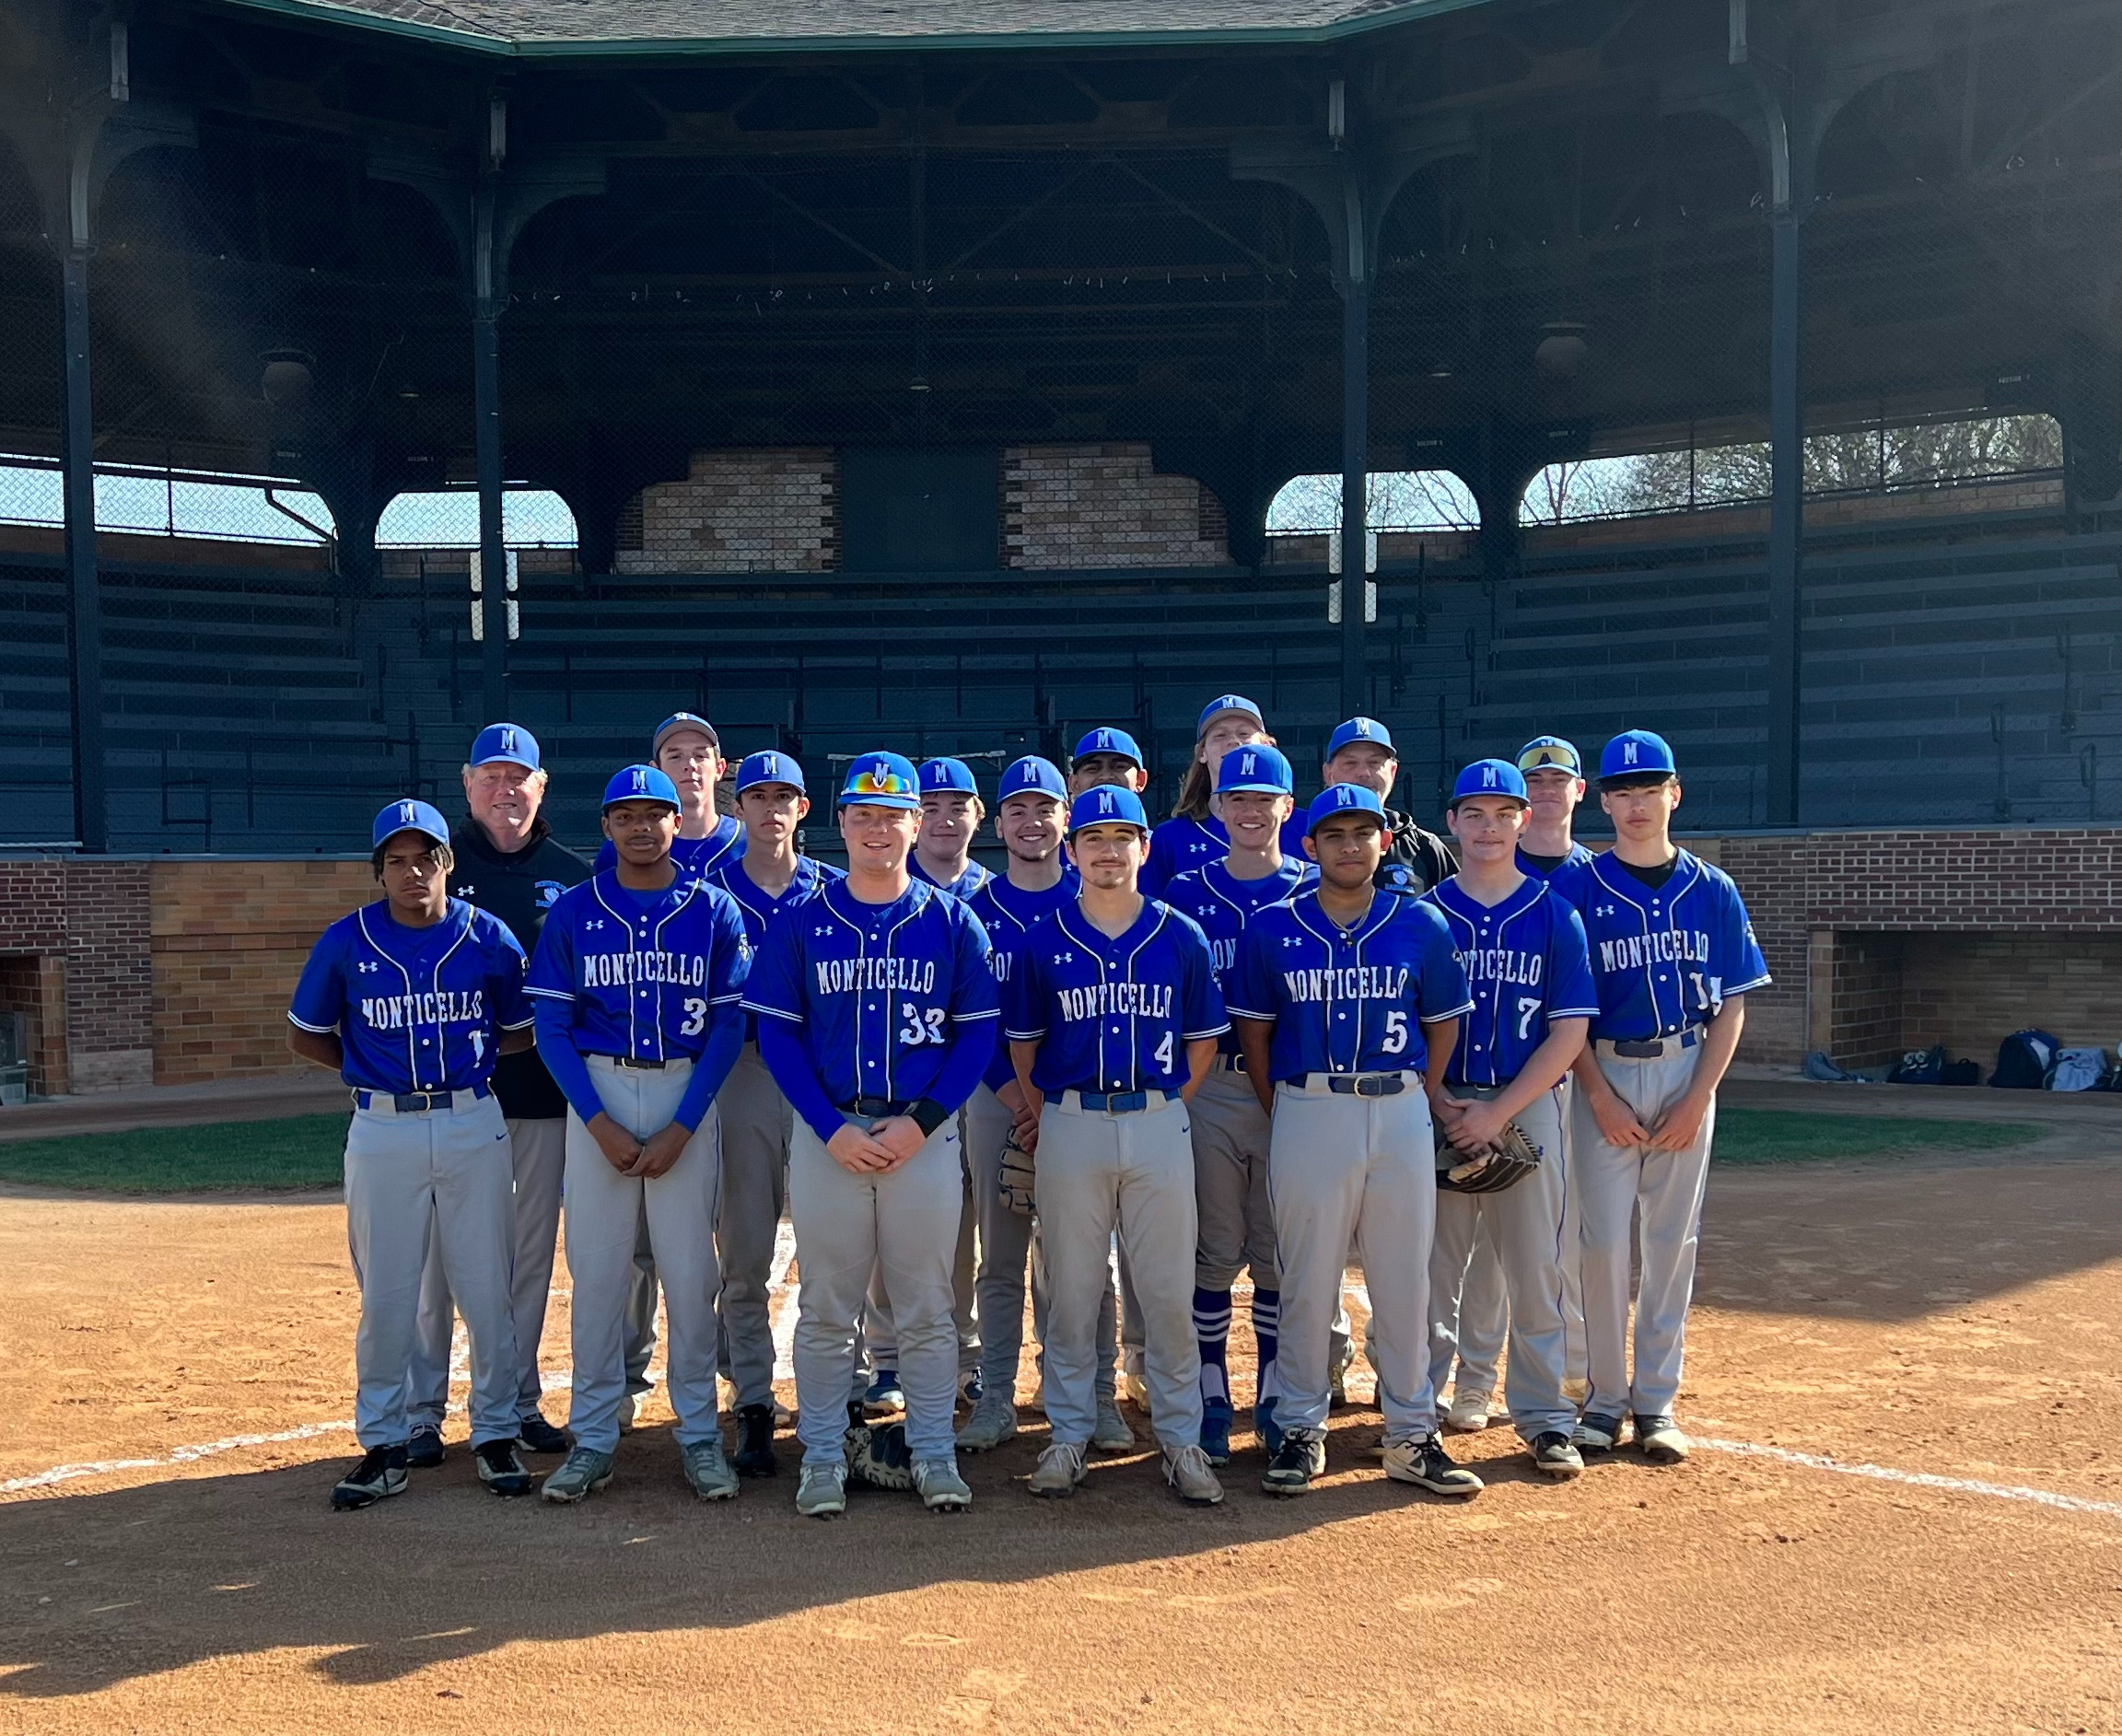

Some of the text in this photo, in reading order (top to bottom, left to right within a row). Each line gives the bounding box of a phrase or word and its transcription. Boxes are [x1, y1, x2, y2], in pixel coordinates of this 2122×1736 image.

[1357, 717, 1370, 737] M
[501, 729, 515, 749] M
[1096, 730, 1111, 748] M
[1623, 742, 1638, 764] M
[764, 756, 777, 775] M
[874, 763, 890, 784] M
[935, 764, 947, 783] M
[1022, 763, 1037, 782] M
[1241, 754, 1255, 775] M
[632, 771, 647, 789] M
[1483, 767, 1497, 787] M
[1099, 792, 1113, 813] M
[1336, 786, 1351, 806] M
[400, 804, 414, 822] M
[1599, 930, 1709, 973] MONTICELLO
[583, 950, 705, 988] MONTICELLO
[815, 958, 935, 995] MONTICELLO
[1459, 949, 1542, 986] NTICELLO
[1283, 965, 1408, 1003] MONTICELLO
[361, 989, 483, 1031] MONTICELLO
[1056, 982, 1172, 1022] MONTICELLO
[680, 997, 707, 1037] 3
[1517, 996, 1542, 1040] 7
[1381, 1010, 1408, 1054] 5
[1154, 1031, 1174, 1075] 4
